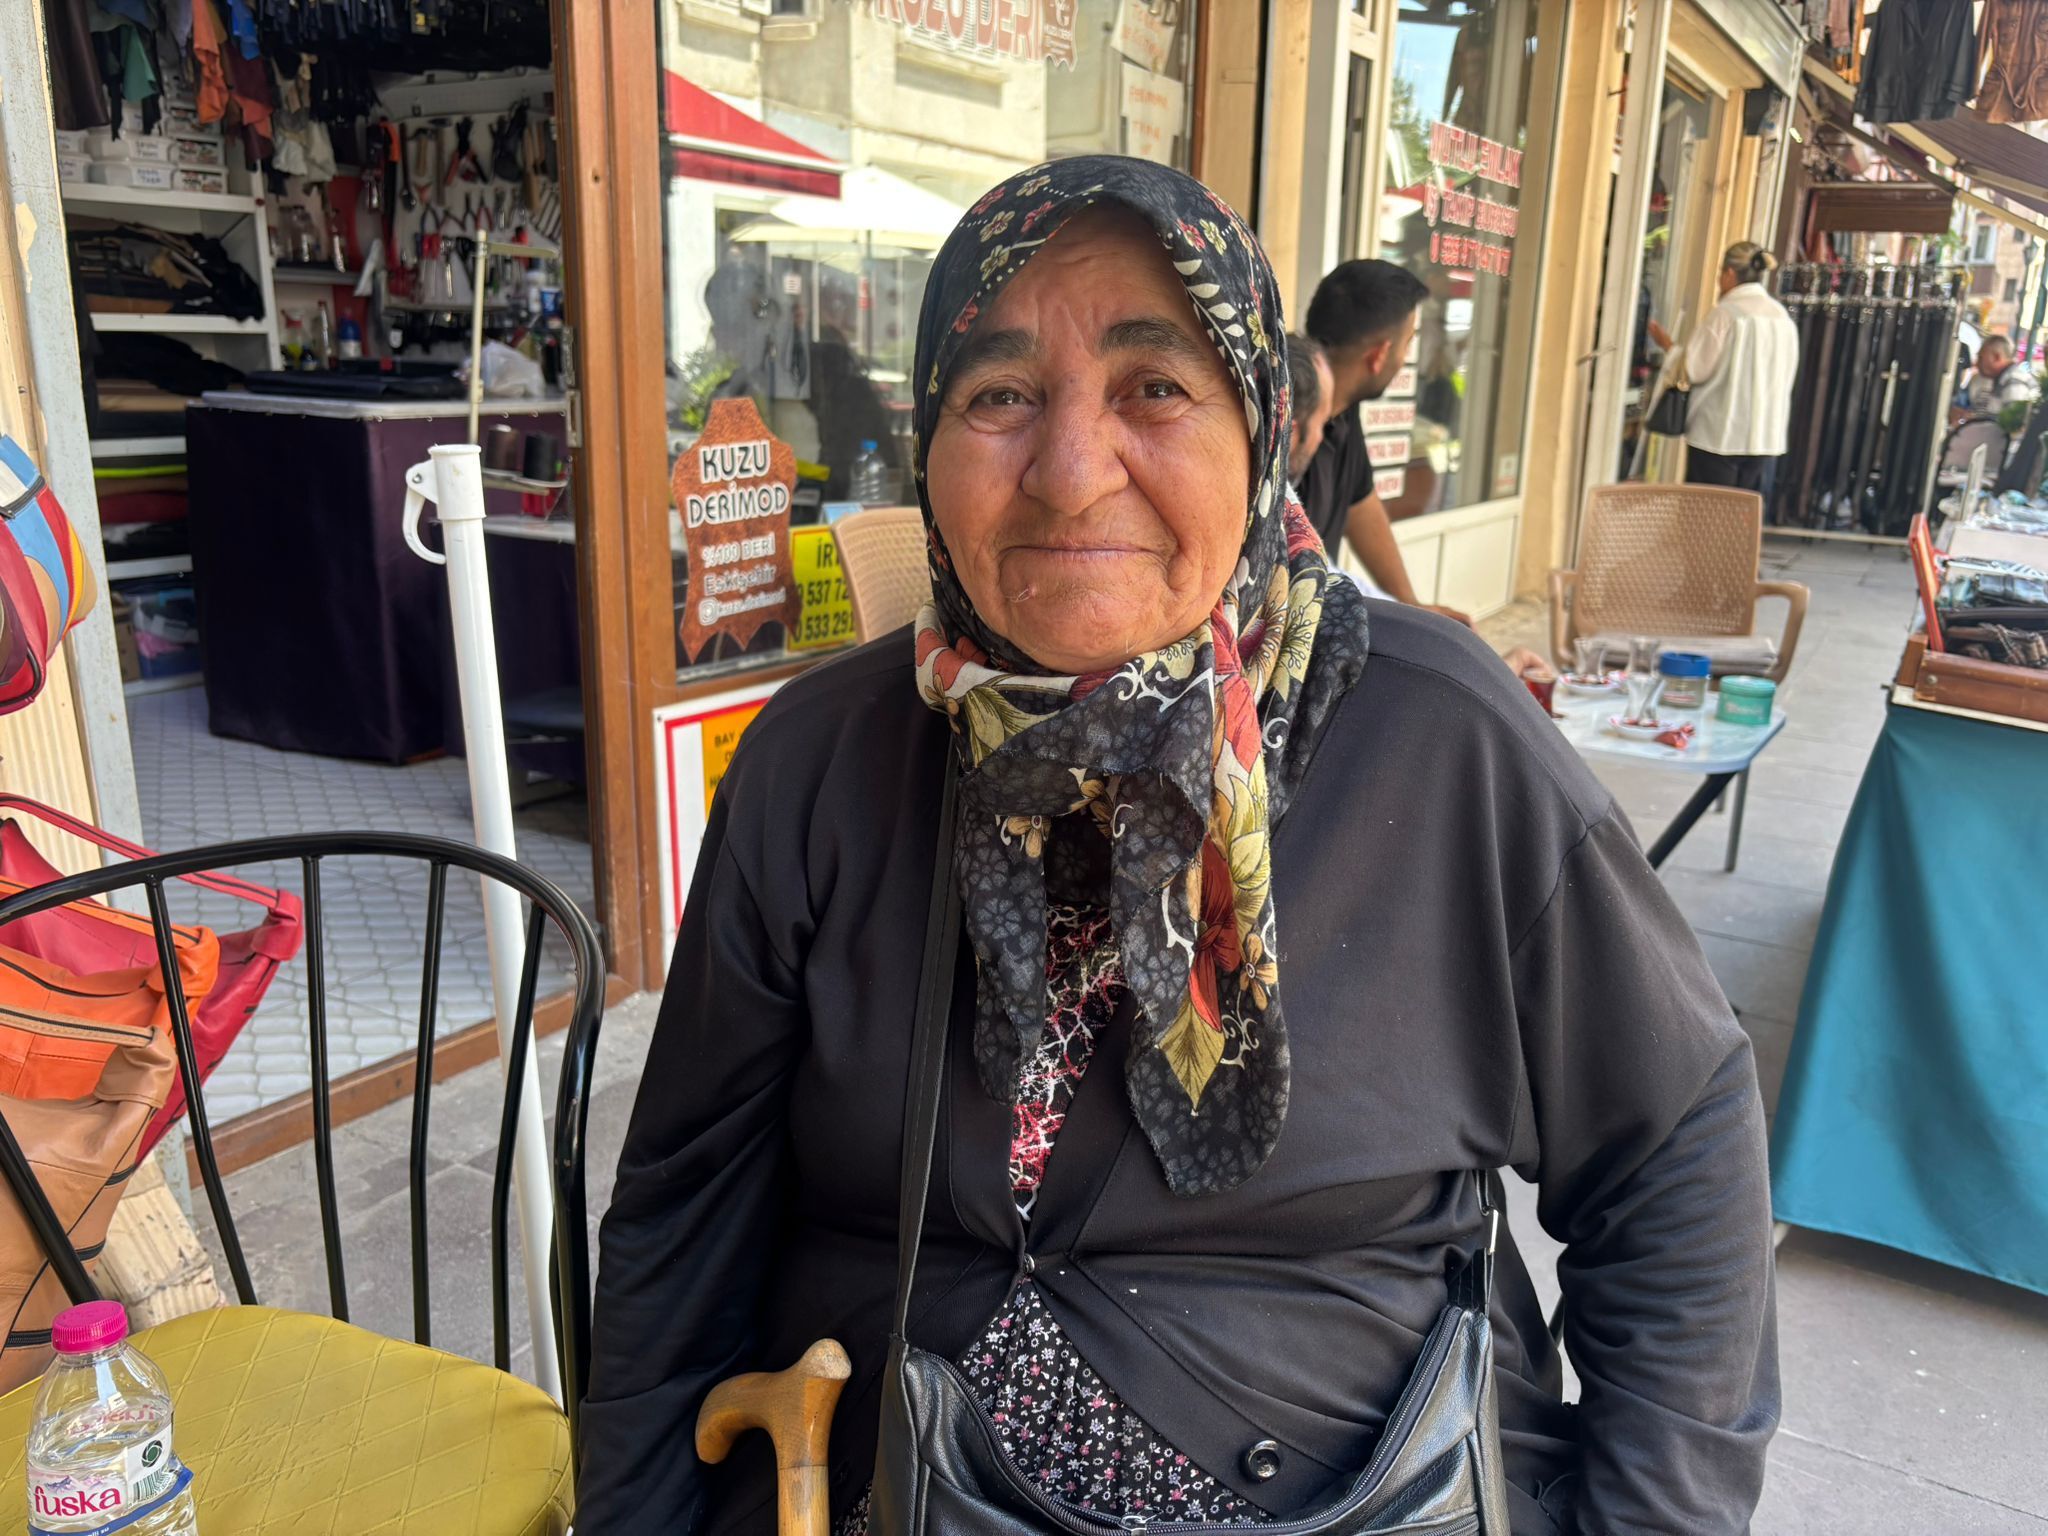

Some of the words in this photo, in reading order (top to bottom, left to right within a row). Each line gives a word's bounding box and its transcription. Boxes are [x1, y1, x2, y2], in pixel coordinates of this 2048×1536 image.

[700, 440, 770, 484] KUZU
[687, 480, 790, 529] DERİMOD
[702, 542, 740, 568] %100
[807, 580, 831, 606] 537
[806, 613, 829, 640] 533
[714, 731, 735, 748] BAY
[35, 1485, 122, 1517] fuska
